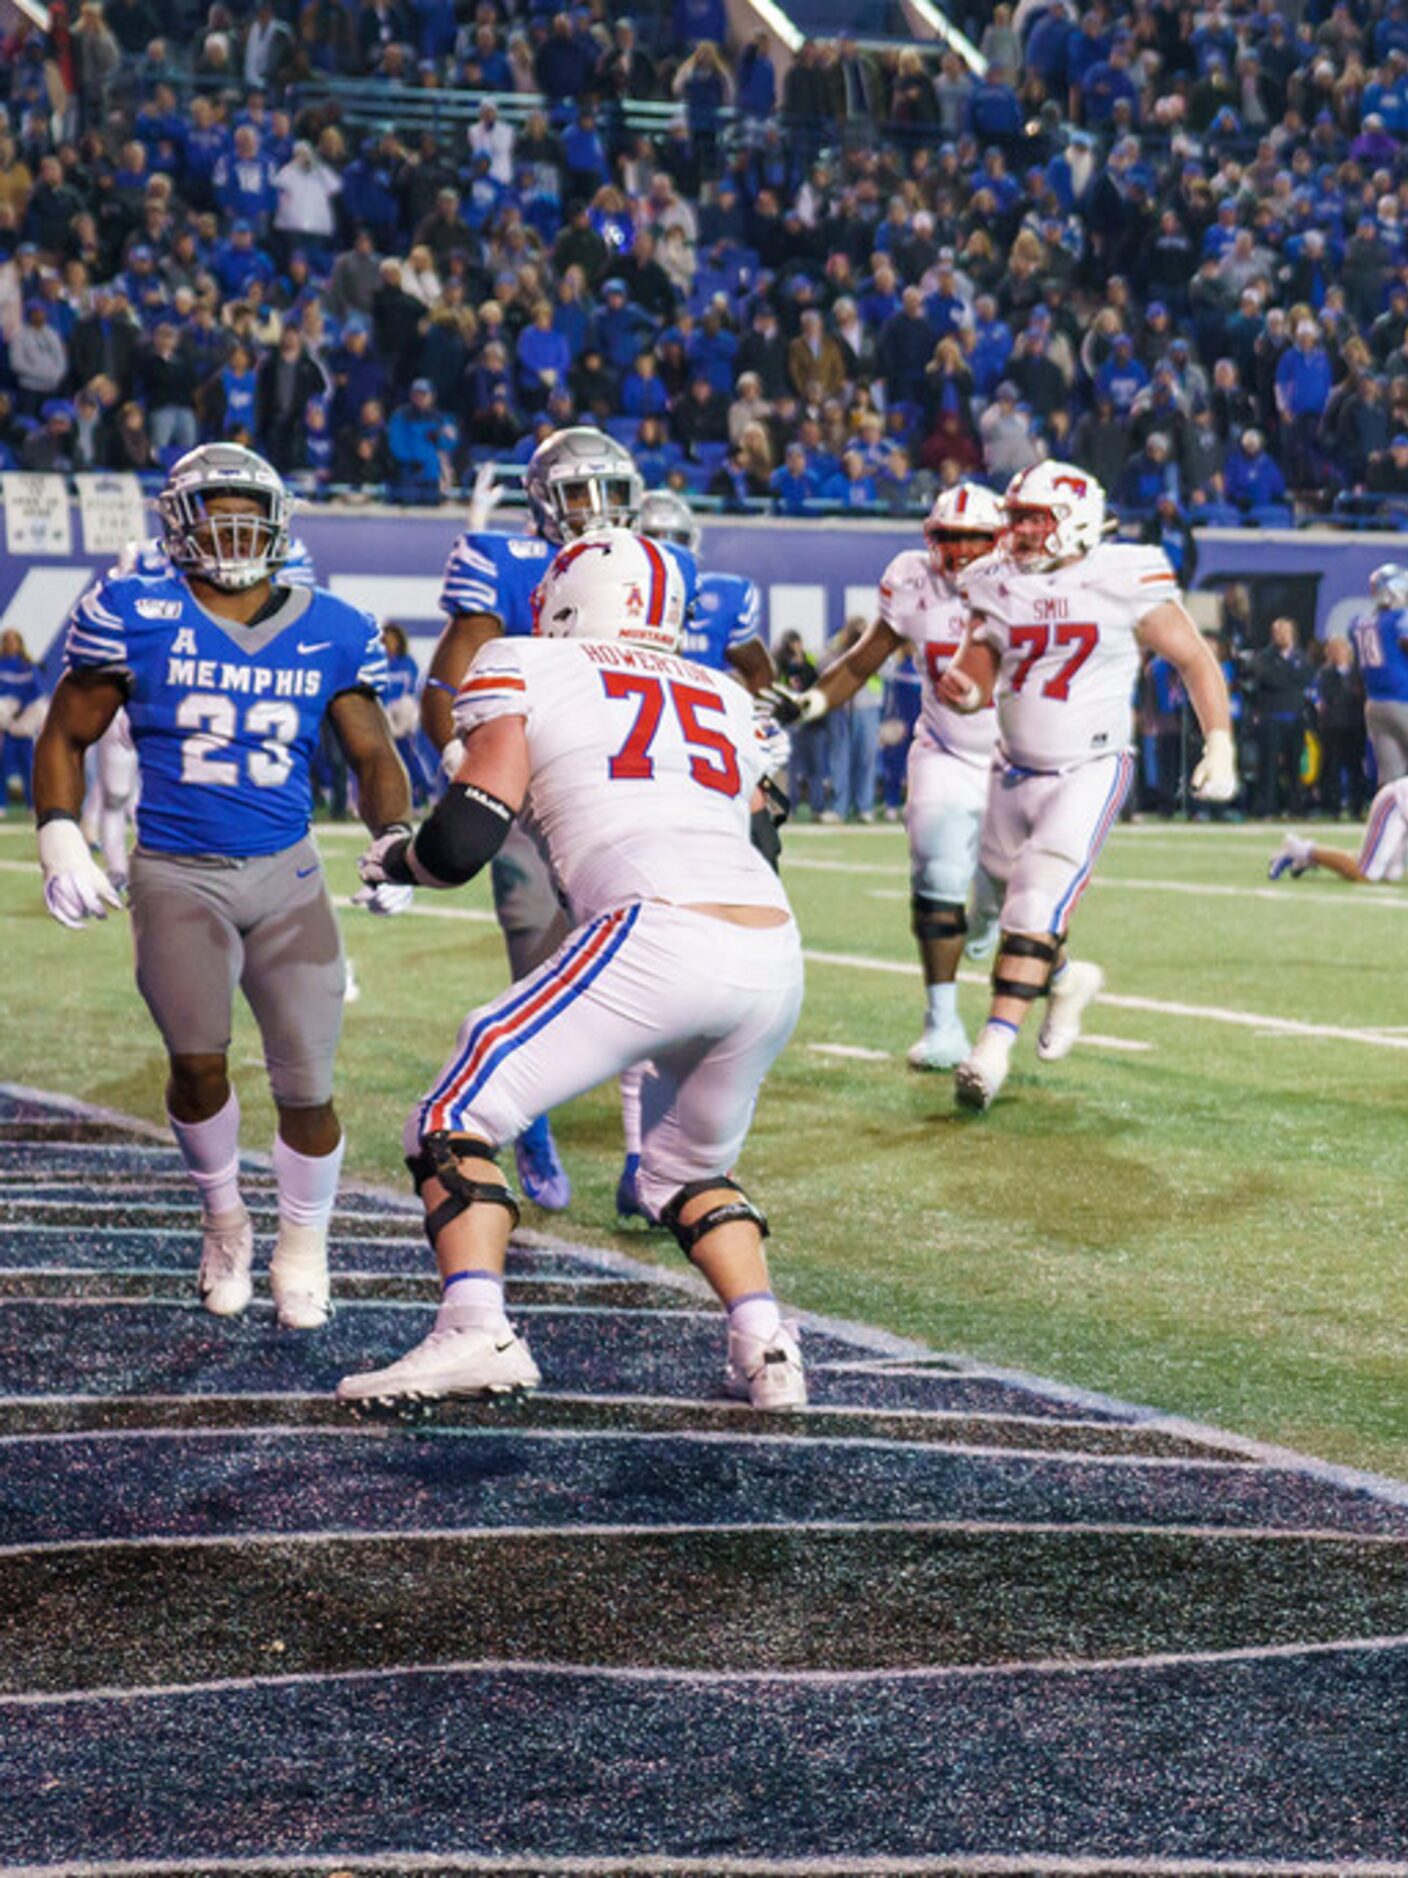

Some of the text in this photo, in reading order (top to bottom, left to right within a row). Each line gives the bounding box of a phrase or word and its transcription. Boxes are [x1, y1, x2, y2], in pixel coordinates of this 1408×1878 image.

[1033, 598, 1069, 621] SMU
[167, 657, 322, 697] MEMPHIS
[580, 643, 716, 687] HOWERTON
[1008, 622, 1099, 702] 77
[175, 692, 299, 787] 23
[598, 667, 742, 800] 75
